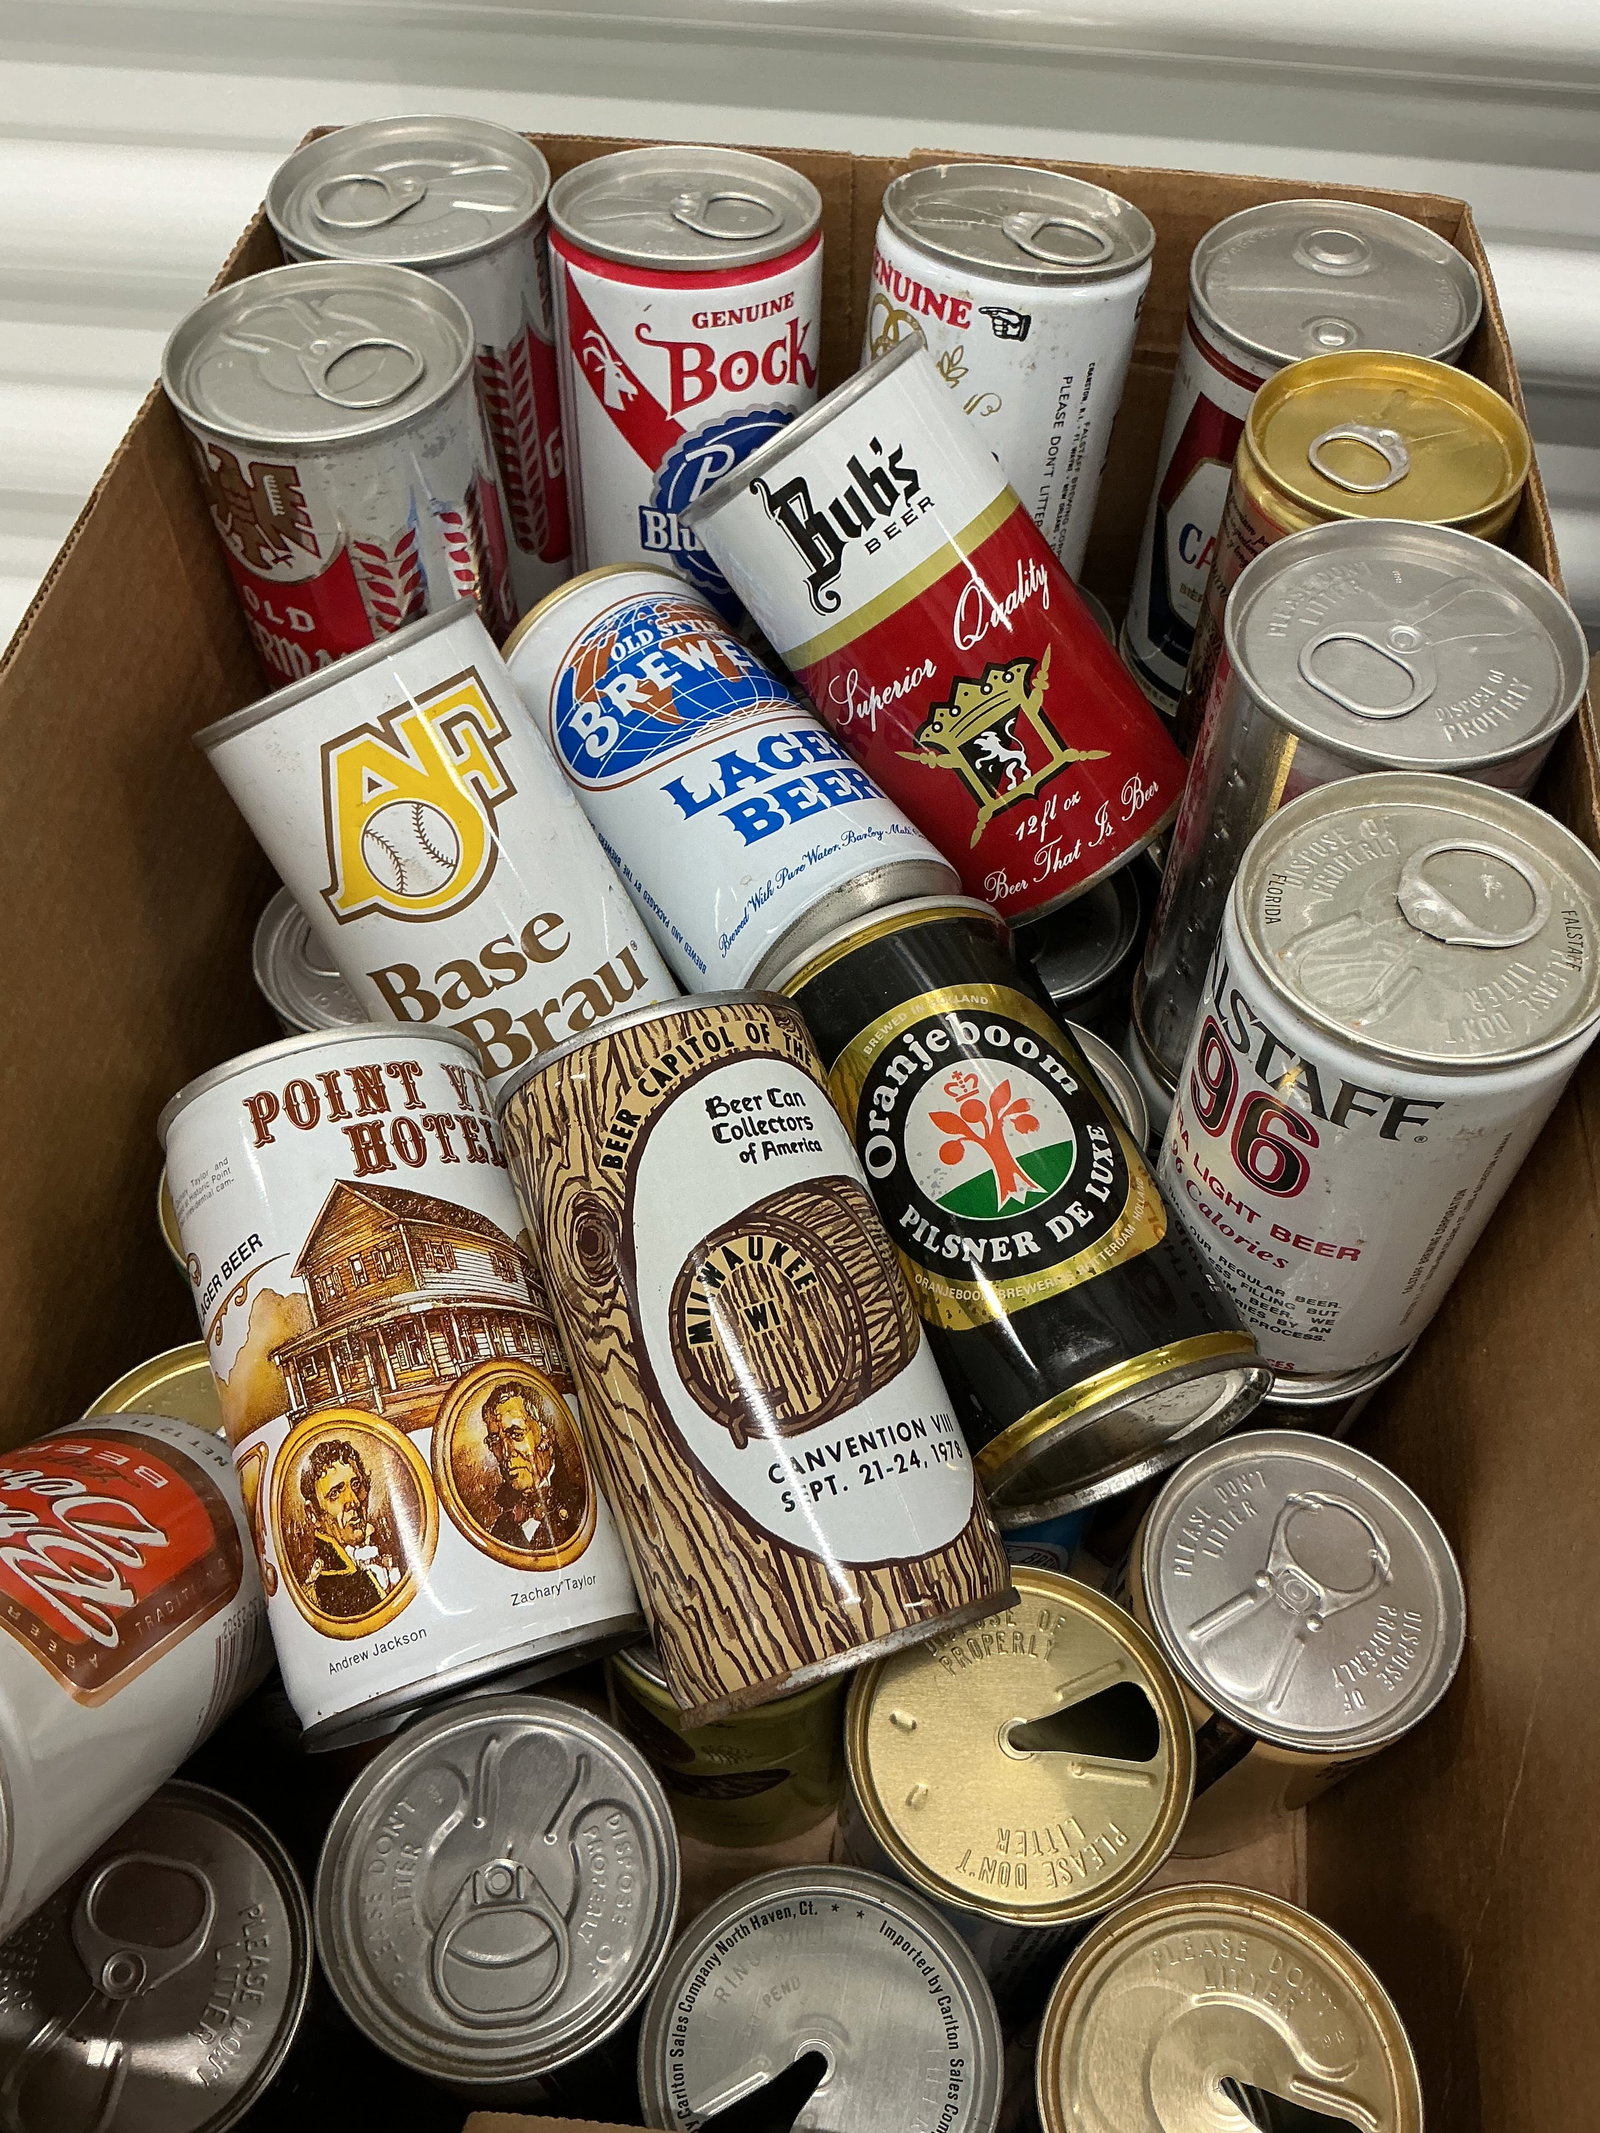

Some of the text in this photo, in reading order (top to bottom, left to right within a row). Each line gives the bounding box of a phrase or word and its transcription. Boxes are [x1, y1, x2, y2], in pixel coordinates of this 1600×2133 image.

[692, 292, 794, 329] GENUINE
[873, 248, 972, 329] ENUINE
[1053, 375, 1073, 429] PLEASE
[1043, 436, 1062, 478] DON'T
[750, 437, 921, 615] Bub's
[865, 495, 936, 555] BEER
[243, 585, 316, 632] OLD
[953, 559, 1050, 651] Quality
[611, 617, 725, 661] OLD STYLE
[829, 658, 937, 731] Superior
[718, 768, 887, 847] BEER
[984, 869, 1028, 902] Beer
[1033, 841, 1081, 883] That
[1121, 772, 1159, 821] Beer
[622, 864, 633, 882] THE
[634, 879, 643, 893] BY
[718, 909, 750, 958] Brewed
[748, 880, 774, 912] With
[775, 862, 806, 890] Pure
[841, 827, 884, 847] Barley
[1264, 873, 1287, 925] FLORIDA
[643, 890, 670, 928] PACKAGED
[670, 927, 684, 944] AND
[684, 941, 707, 974] BREWED
[1561, 910, 1583, 972] FALSTAFF
[367, 912, 571, 1024] Base
[447, 946, 649, 1080] Brau
[863, 1013, 908, 1056] BREWED
[911, 1003, 925, 1017] IN
[243, 1060, 426, 1149] POINT
[601, 1023, 813, 1170] BEER CAPITOL OF THE
[704, 1087, 807, 1120] Beer Can
[865, 1012, 1080, 1179] Oranjeboom
[1190, 1015, 1320, 1199] 96
[341, 1113, 508, 1177] HOTEL
[712, 1114, 814, 1144] Collectors
[739, 1139, 823, 1166] of America
[190, 1157, 229, 1188] Taylor and
[211, 1168, 231, 1184] Point
[216, 1179, 235, 1193] cam-
[899, 1124, 1115, 1264] PILSNER DE LUXE
[1186, 1179, 1289, 1270] Calories
[1193, 1153, 1362, 1262] LIGHT BEER
[220, 1233, 264, 1281] BEER
[1189, 1225, 1212, 1253] OUR
[1218, 1255, 1286, 1298] REGULAR
[1295, 1295, 1342, 1310] BEER.
[743, 1300, 781, 1333] WI
[1240, 1282, 1296, 1311] FILLING
[1307, 1307, 1339, 1318] BUT
[1248, 1297, 1294, 1320] BEER.
[1311, 1317, 1336, 1327] WE
[1249, 1316, 1327, 1343] PROCESS.
[1276, 1317, 1332, 1336] BY AN
[160, 1427, 182, 1438] 12
[929, 1413, 955, 1434] VIII
[189, 1440, 228, 1467] NET
[858, 1441, 964, 1485] 21-24, 1978
[1174, 1471, 1268, 1578] PLEASE DON'T
[1203, 1500, 1259, 1560] LITTER
[511, 1574, 597, 1607] Zachary Taylor
[1037, 1608, 1067, 1635] OF
[1332, 1604, 1399, 1689] PROPERLY
[328, 1627, 428, 1676] Andrew Jackson
[939, 1630, 1054, 1677] PROPERLY
[1343, 1610, 1422, 1714] DISPOSE OF
[956, 1823, 1130, 1890] PLEASE DON'T
[997, 1816, 1086, 1859] LITTER
[750, 1905, 797, 1931] Haven,
[799, 1901, 818, 1916] Ct.
[715, 1923, 751, 1956] North
[189, 1940, 241, 2046] LITTER
[196, 1902, 271, 2086] PLEASE DON'T
[678, 1953, 721, 2013] Company
[1151, 1936, 1339, 2016] PLEASE DON'T
[1203, 1965, 1295, 2020] LITTER
[670, 2016, 689, 2057] Sales
[879, 1920, 965, 2105] Imported by Carlton Sales
[671, 2063, 692, 2119] Carlton
